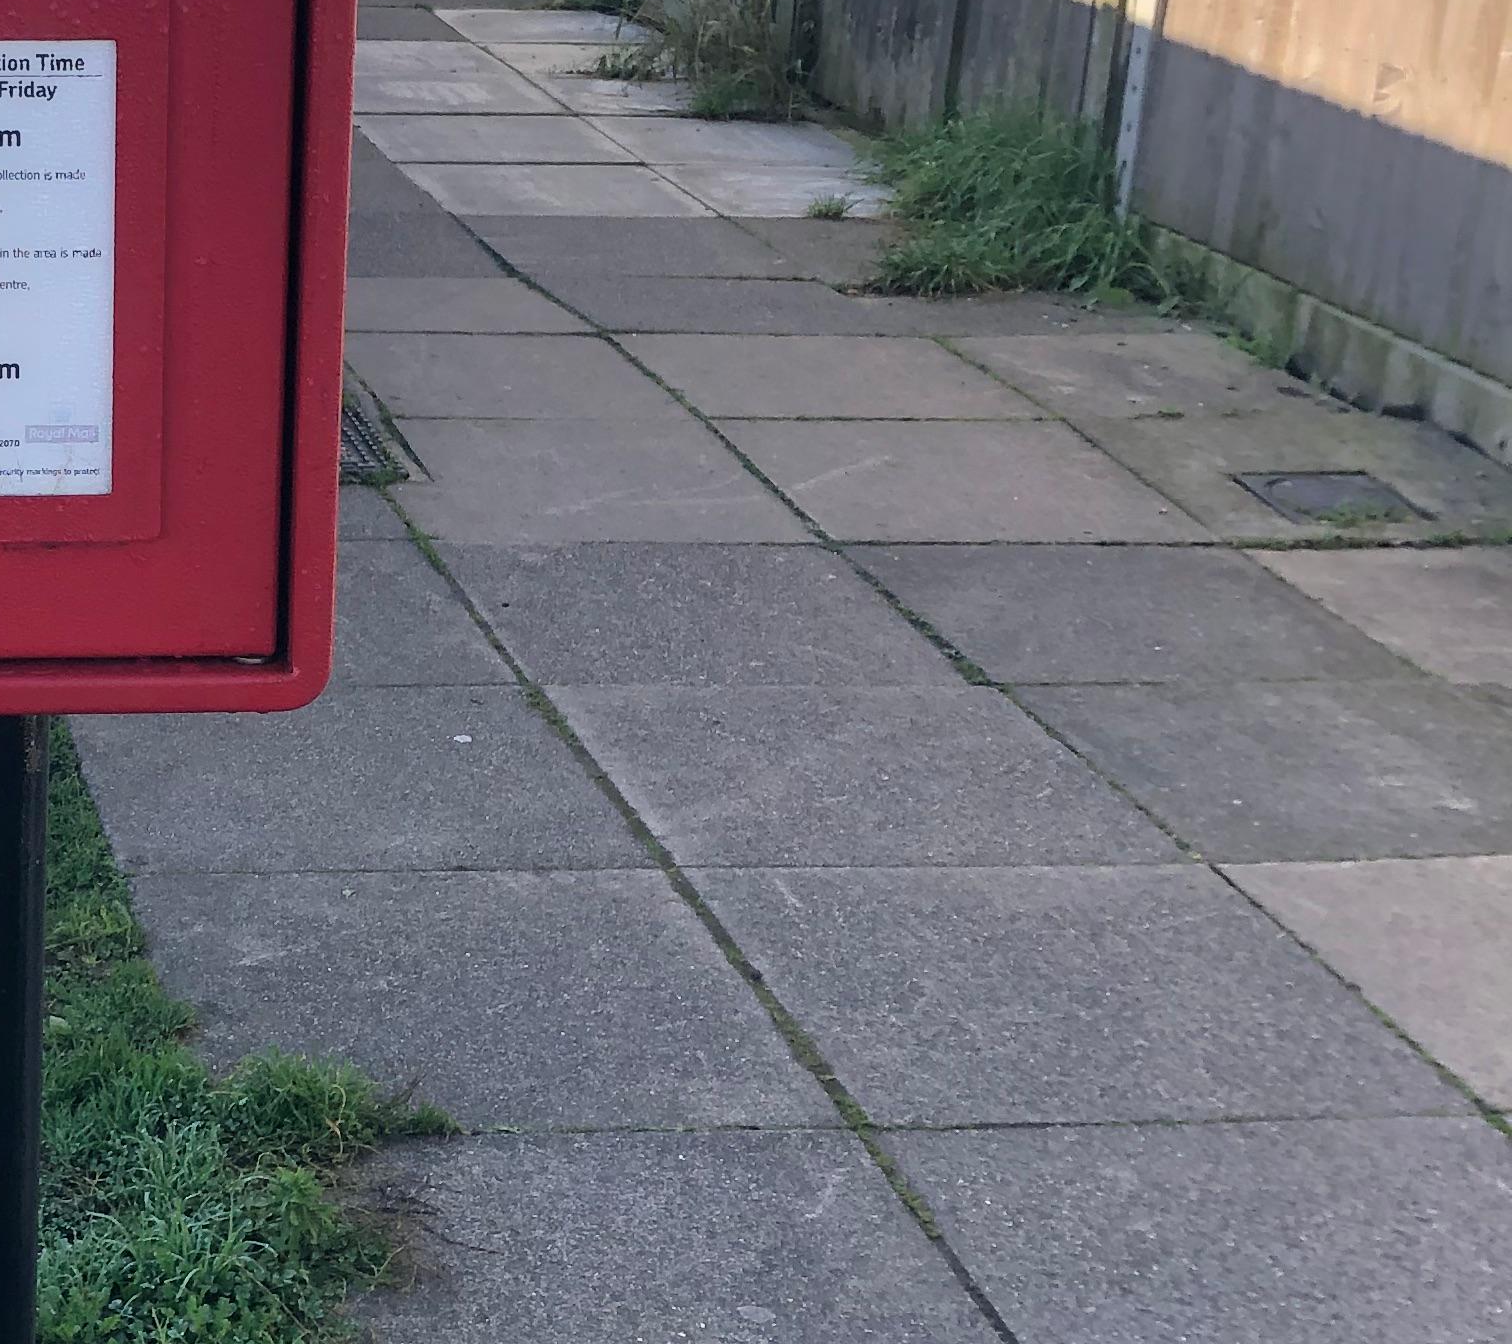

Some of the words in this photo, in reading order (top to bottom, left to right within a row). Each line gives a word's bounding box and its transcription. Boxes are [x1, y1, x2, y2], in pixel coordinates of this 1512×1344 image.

[36, 54, 85, 71] Time
[44, 170, 52, 180] is
[56, 169, 86, 180] made
[0, 248, 9, 258] in
[13, 248, 30, 258] the
[34, 249, 56, 259] area
[60, 248, 69, 258] is
[73, 248, 102, 258] made
[64, 468, 72, 476] to
